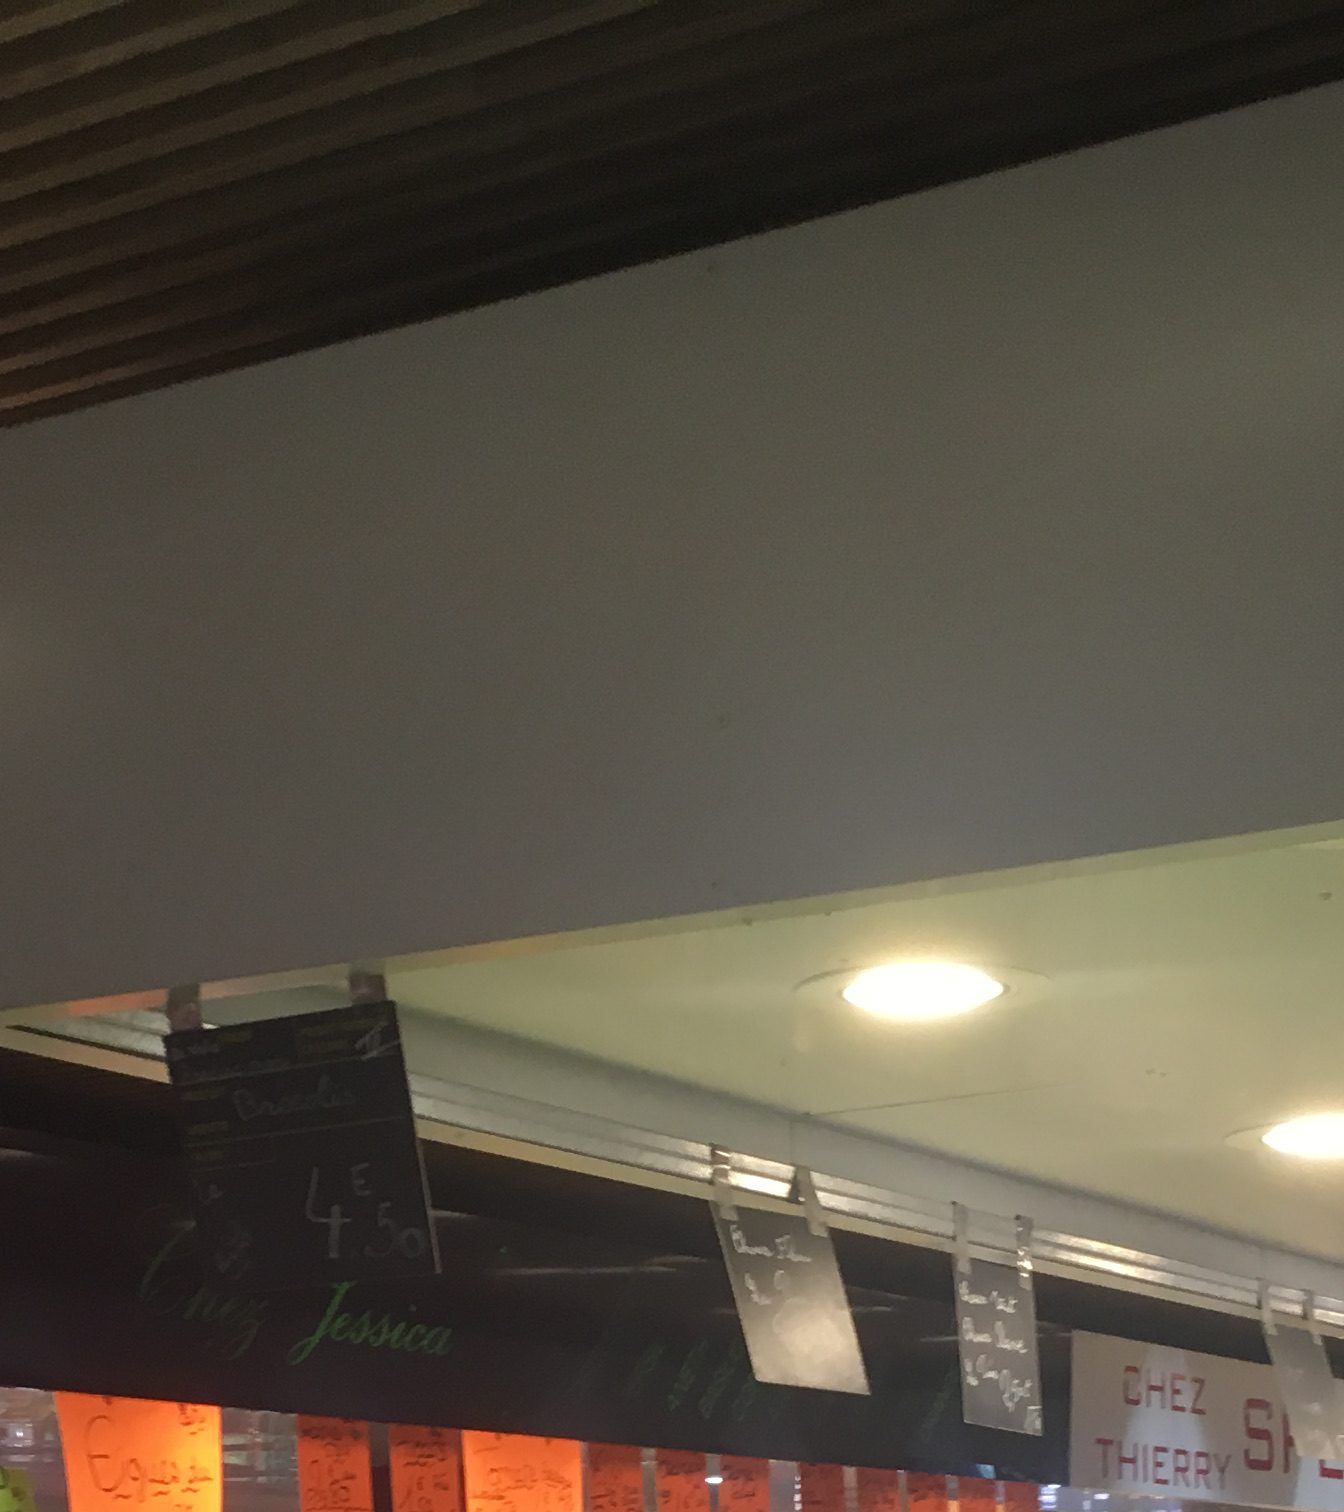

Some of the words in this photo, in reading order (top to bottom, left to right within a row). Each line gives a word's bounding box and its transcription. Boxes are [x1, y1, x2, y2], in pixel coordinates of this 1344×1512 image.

[287, 1281, 454, 1366] Jessica
[1121, 1364, 1207, 1417] CHEZ
[1094, 1437, 1233, 1491] THIERRY
